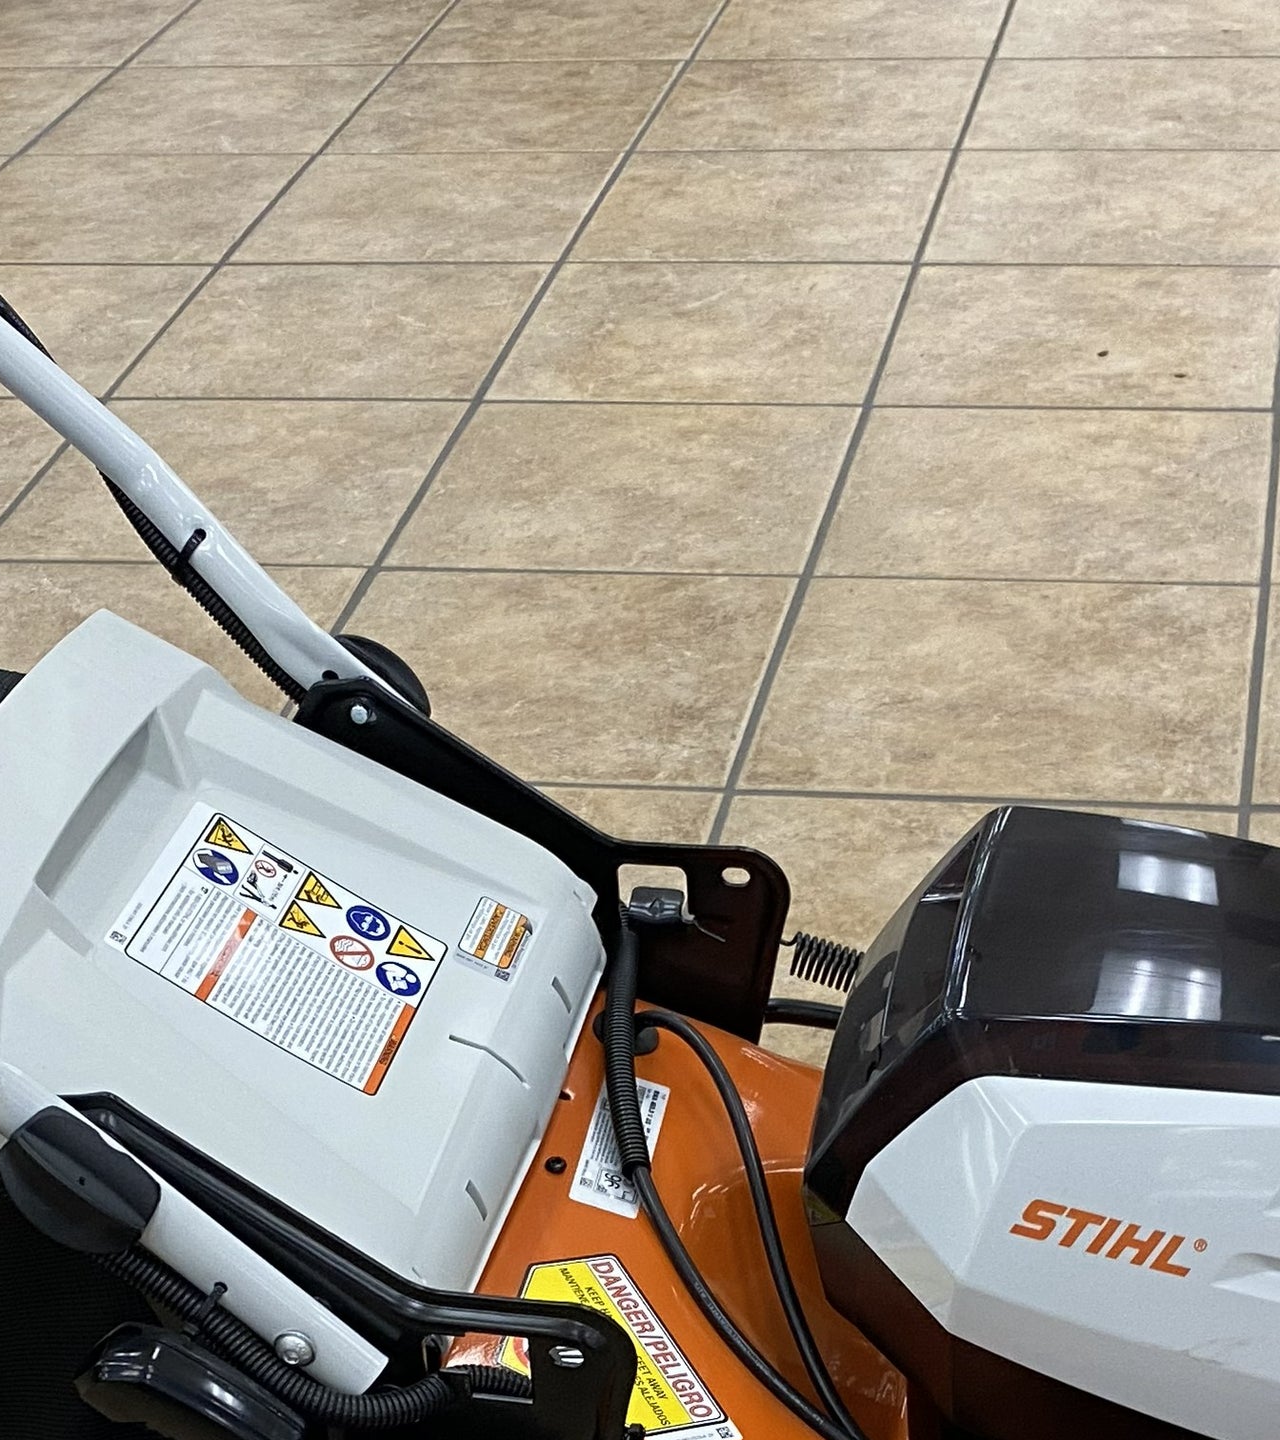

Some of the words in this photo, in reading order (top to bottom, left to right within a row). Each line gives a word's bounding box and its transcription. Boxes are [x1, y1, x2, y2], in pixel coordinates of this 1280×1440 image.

[1009, 1199, 1191, 1277] STIHL
[559, 1268, 590, 1304] MANTIENE
[585, 1286, 605, 1307] KEEP
[591, 1261, 713, 1418] DANGER/PELIGRO
[638, 1387, 671, 1426] ALEJADOS
[646, 1378, 668, 1400] AWAY
